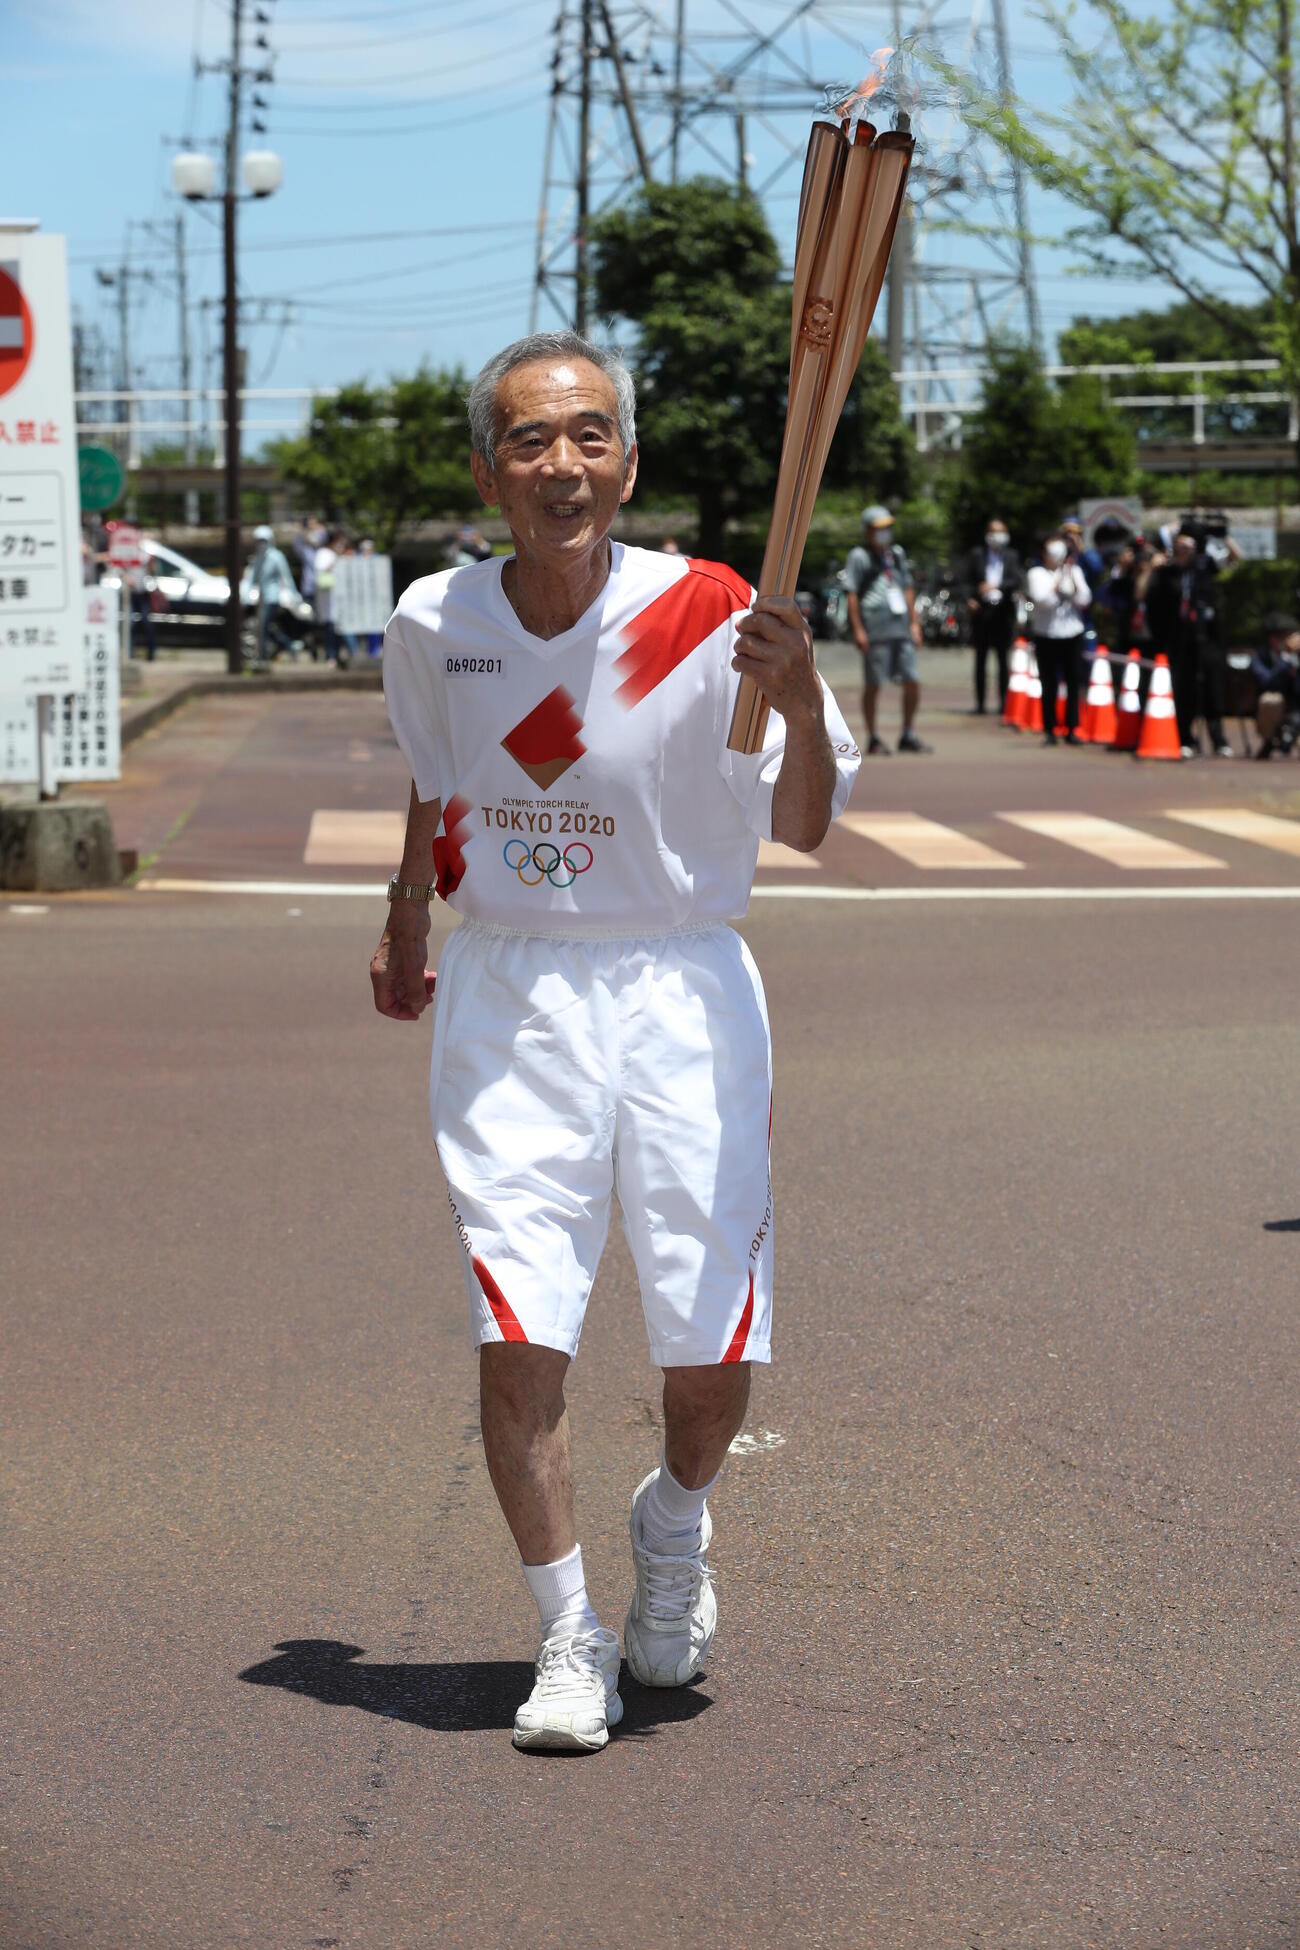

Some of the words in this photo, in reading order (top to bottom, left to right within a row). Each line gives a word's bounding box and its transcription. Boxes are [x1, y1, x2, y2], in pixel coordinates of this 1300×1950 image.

[446, 658, 502, 673] 0690201
[502, 797, 534, 809] OLYMPIC
[535, 800, 563, 809] TORCH
[565, 800, 590, 810] RELAY
[481, 806, 553, 834] TOKYO
[558, 811, 615, 837] 2020
[748, 1207, 772, 1261] TOKYO
